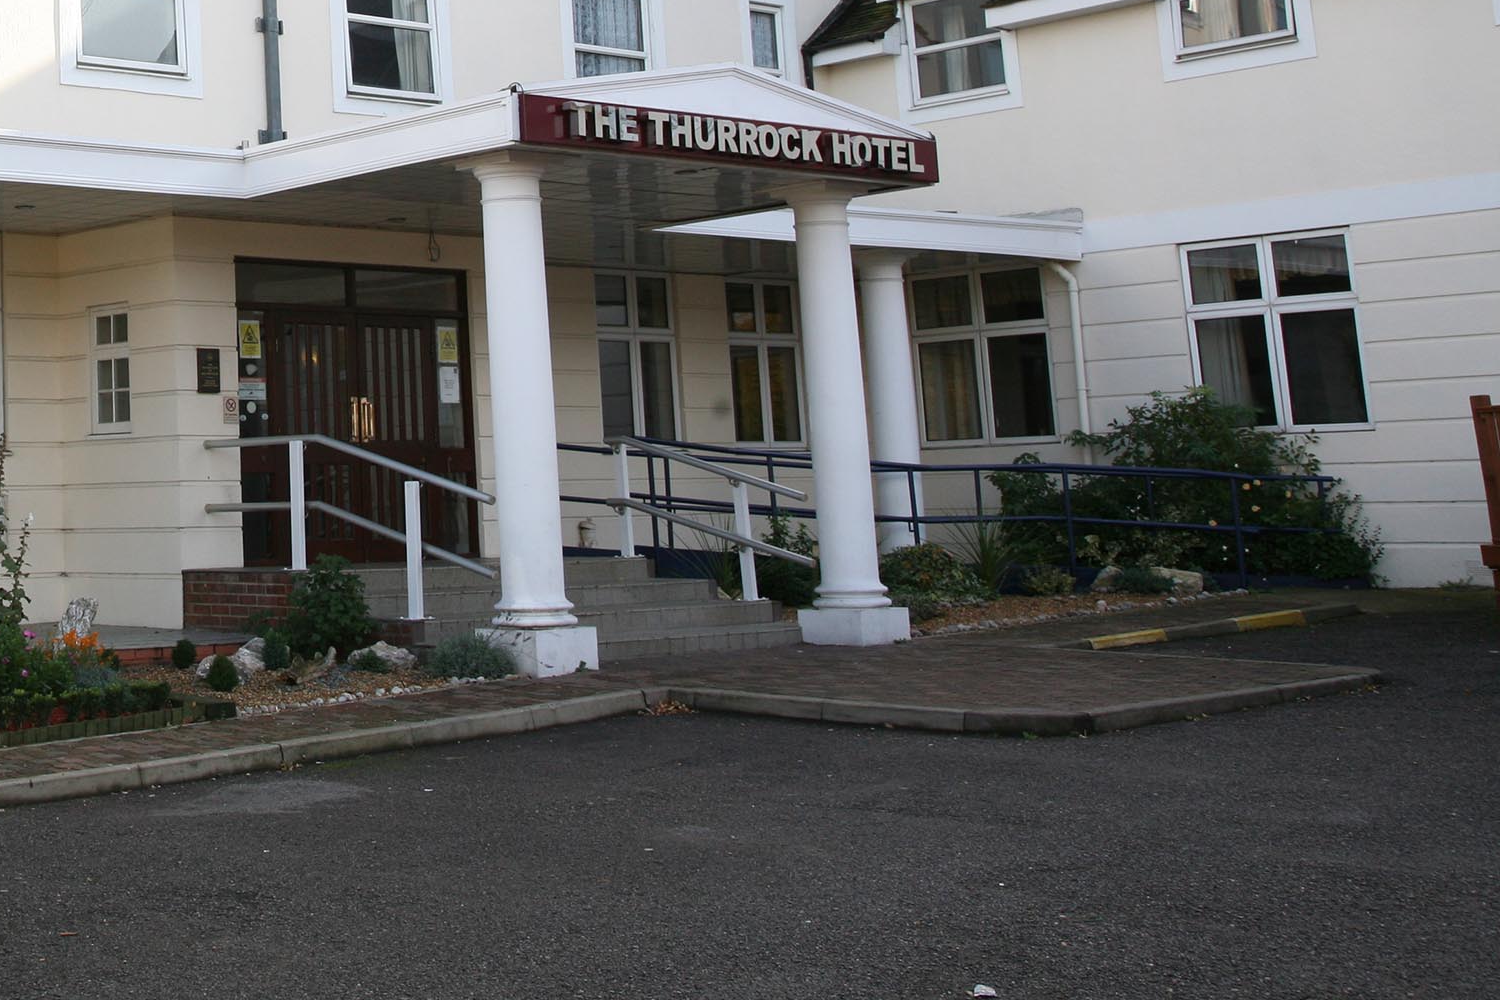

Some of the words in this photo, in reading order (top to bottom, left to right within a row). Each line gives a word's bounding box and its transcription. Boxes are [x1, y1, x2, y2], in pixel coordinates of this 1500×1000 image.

[565, 101, 637, 142] THE
[648, 111, 823, 163] THURROCK
[832, 132, 925, 174] HOTEL
